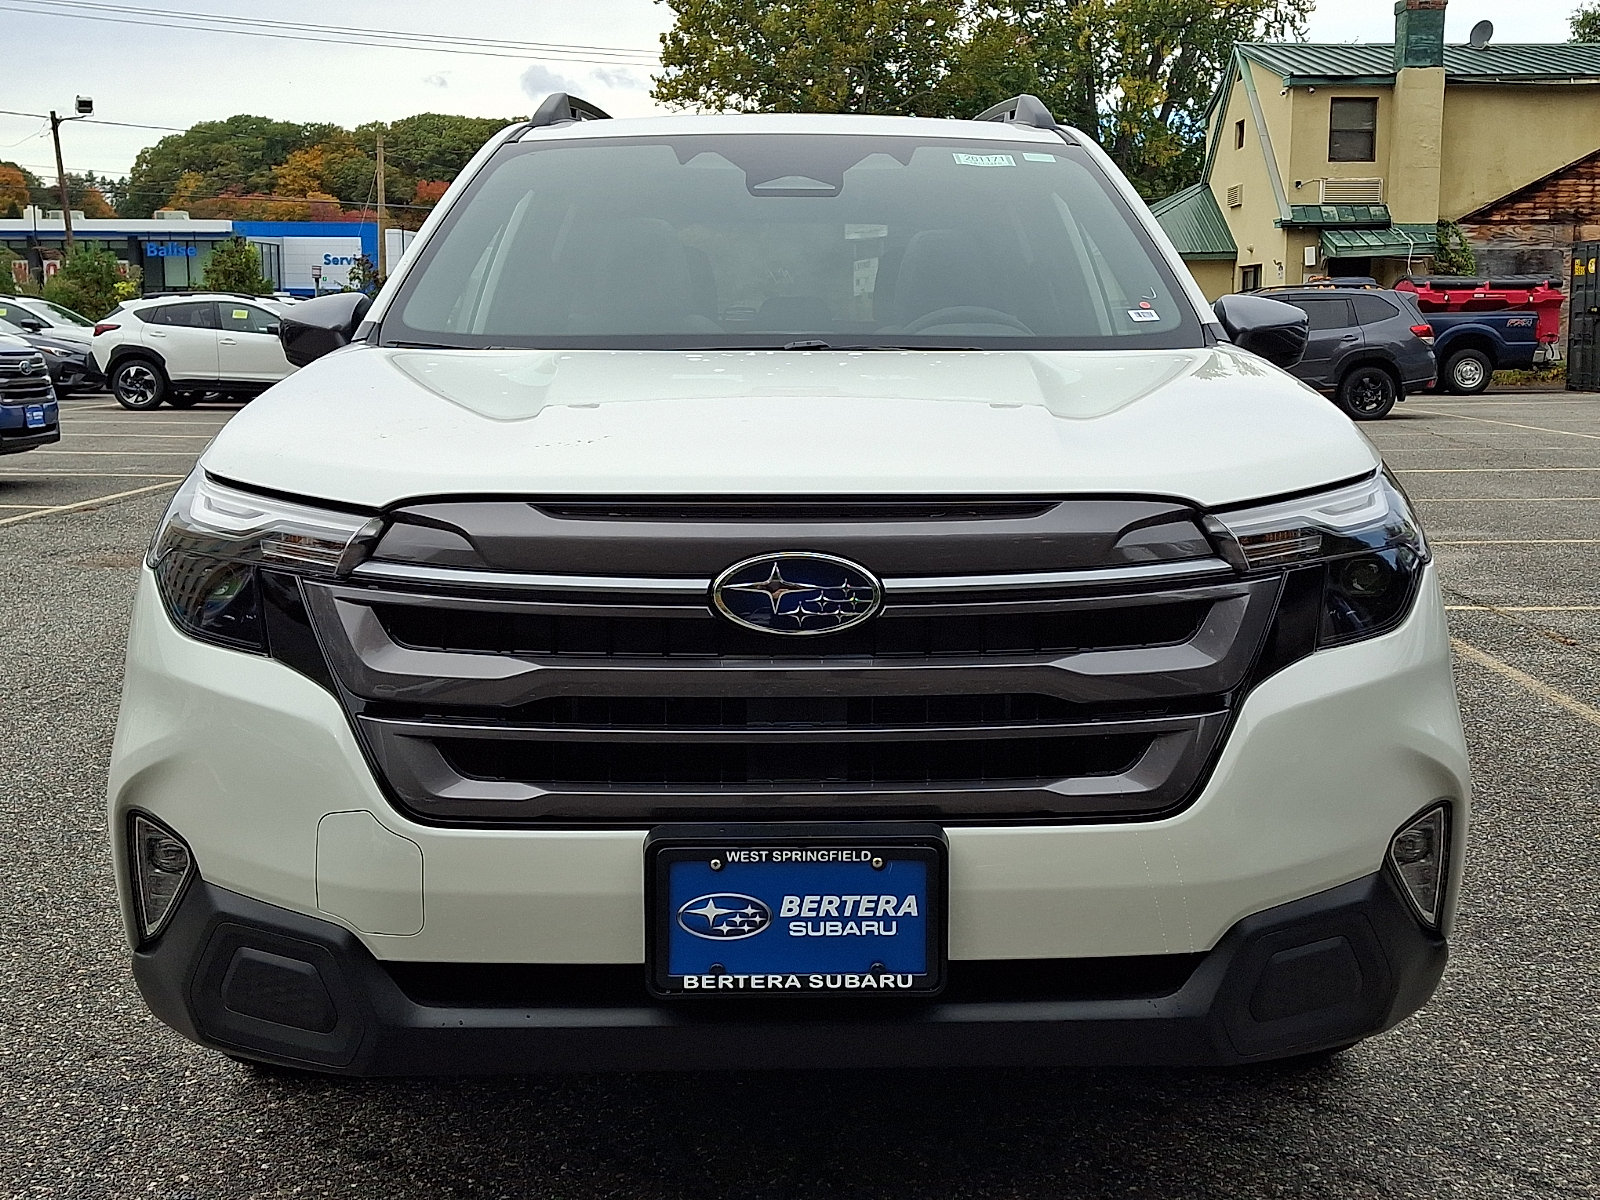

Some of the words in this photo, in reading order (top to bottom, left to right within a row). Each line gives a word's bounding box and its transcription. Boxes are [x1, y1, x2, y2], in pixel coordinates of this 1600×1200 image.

[146, 242, 197, 257] Balise
[323, 253, 361, 266] Servi
[726, 851, 769, 862] WEST
[772, 850, 872, 862] SPRINGFIELD
[779, 895, 919, 917] BERTERA
[788, 921, 898, 936] SUBARU
[683, 974, 802, 989] BERTERA
[808, 974, 913, 989] SUBARU
